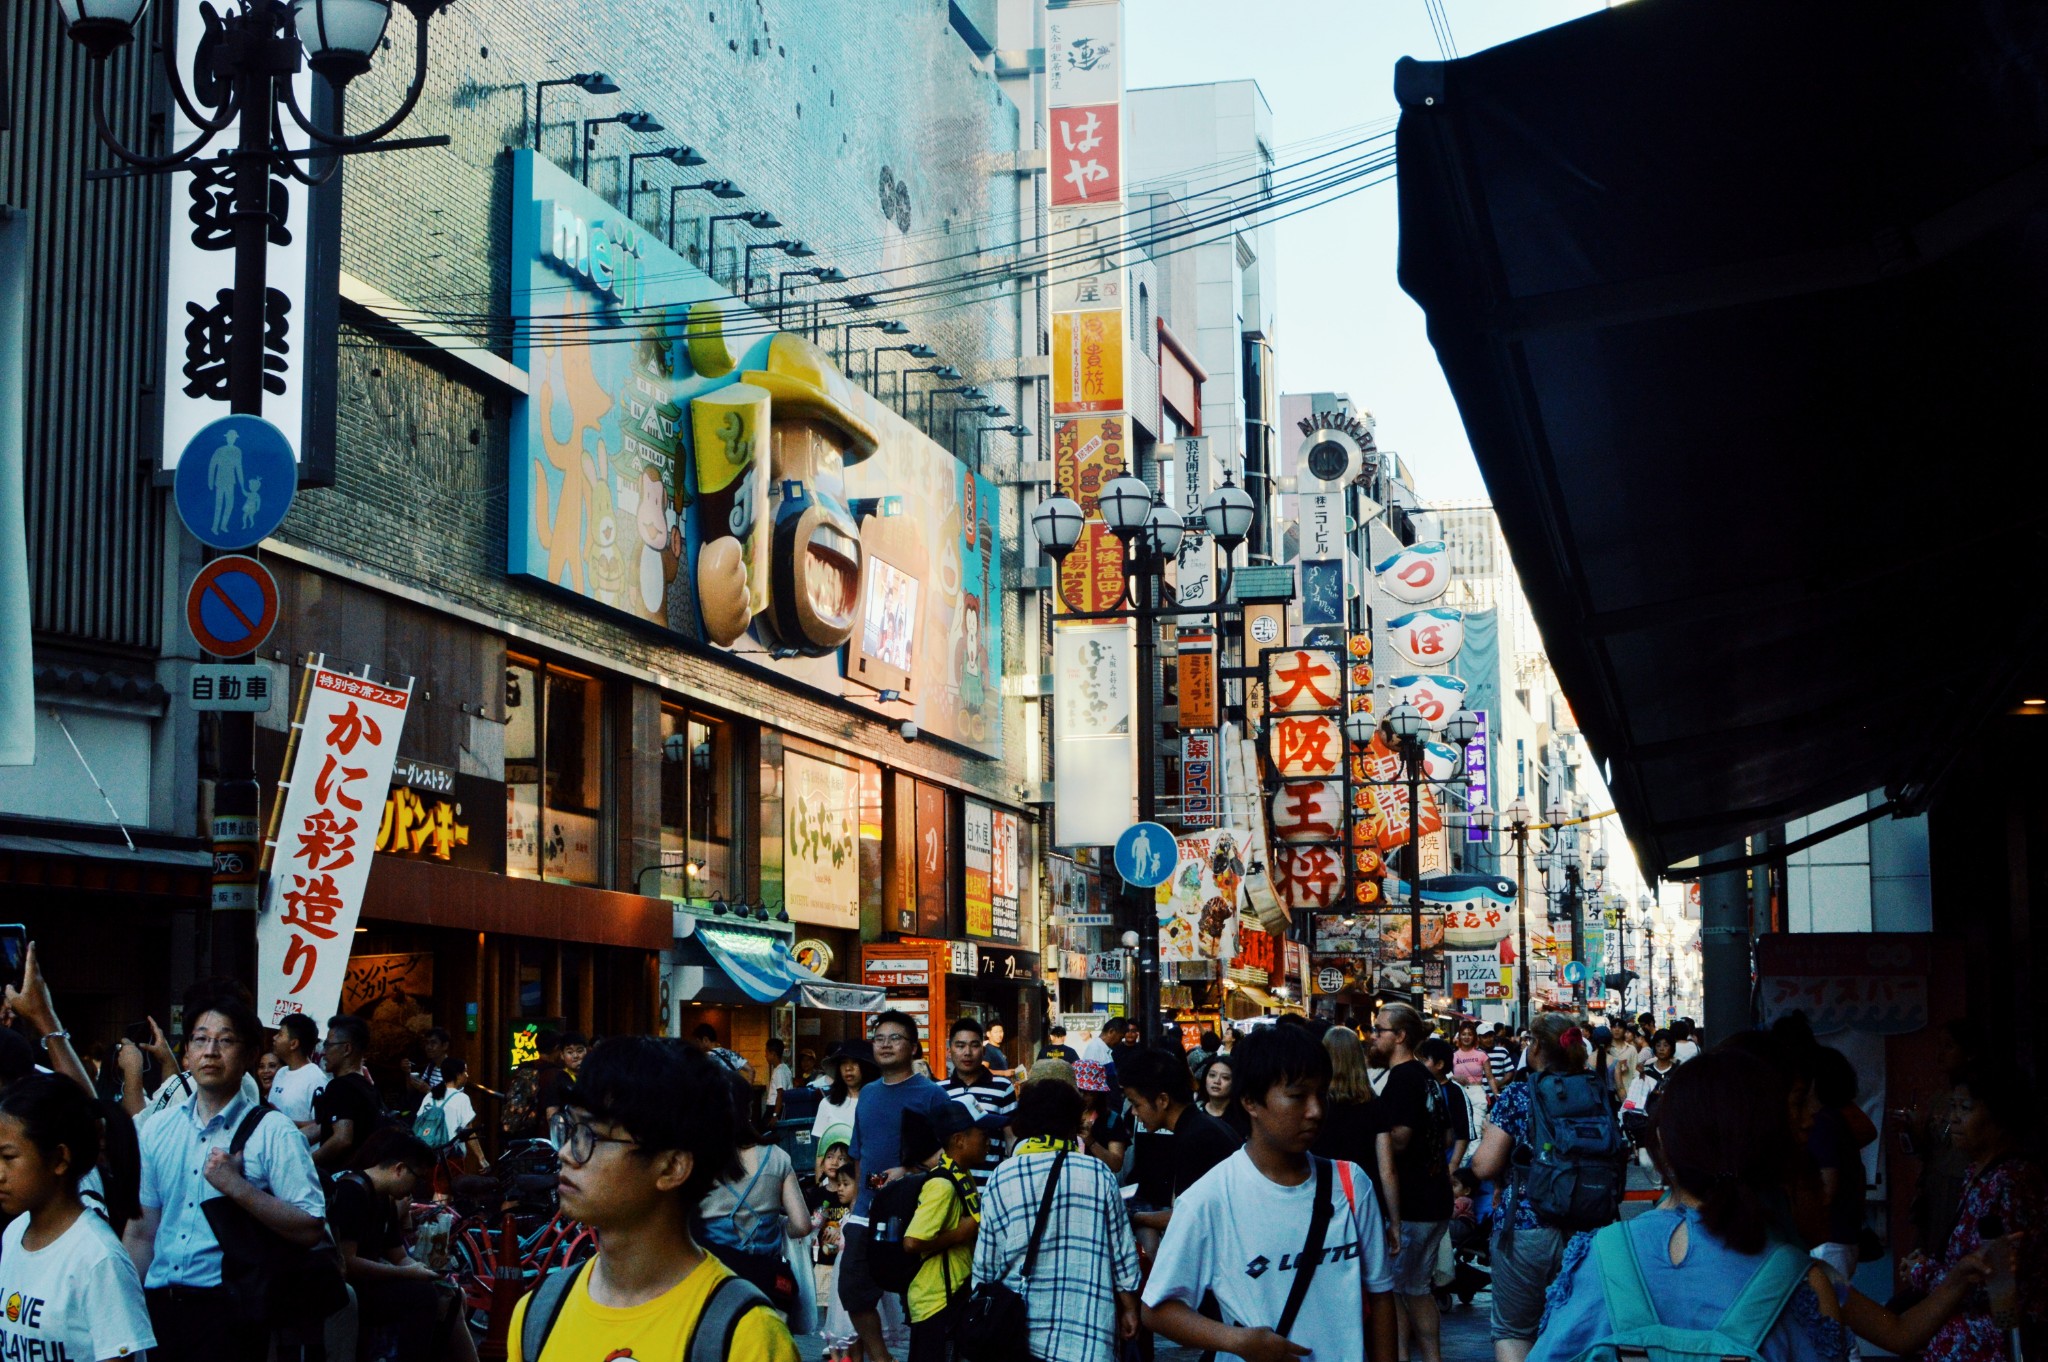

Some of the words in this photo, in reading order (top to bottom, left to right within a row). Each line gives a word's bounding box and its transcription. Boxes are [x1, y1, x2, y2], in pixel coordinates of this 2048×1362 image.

[1060, 111, 1109, 199] はや
[1054, 215, 1071, 229] 4F
[552, 204, 645, 324] meiji
[1074, 217, 1117, 303] 白木屋
[1054, 421, 1064, 429] 3F
[1186, 440, 1200, 516] 浪花囲碁サロン
[1095, 534, 1124, 623] 豊後高田ど
[1178, 574, 1209, 604] Leaf
[193, 675, 267, 701] 自動車
[319, 674, 405, 705] 特別会席フェア
[1190, 656, 1202, 713] ミティラー
[1116, 724, 1127, 733] 2F
[1187, 735, 1208, 759] 薬
[1188, 762, 1208, 810] ダイコク
[1270, 651, 1341, 908] 大阪王将
[281, 701, 382, 994] かに彩造り
[1421, 835, 1440, 867] 焼肉
[849, 901, 858, 917] 2F
[902, 911, 910, 928] 3F
[1444, 911, 1501, 929] ぼらや
[982, 956, 995, 973] 7F
[1457, 968, 1497, 980] PIZZA
[1486, 985, 1500, 995] 2F
[1065, 1021, 1102, 1031] マッサージ
